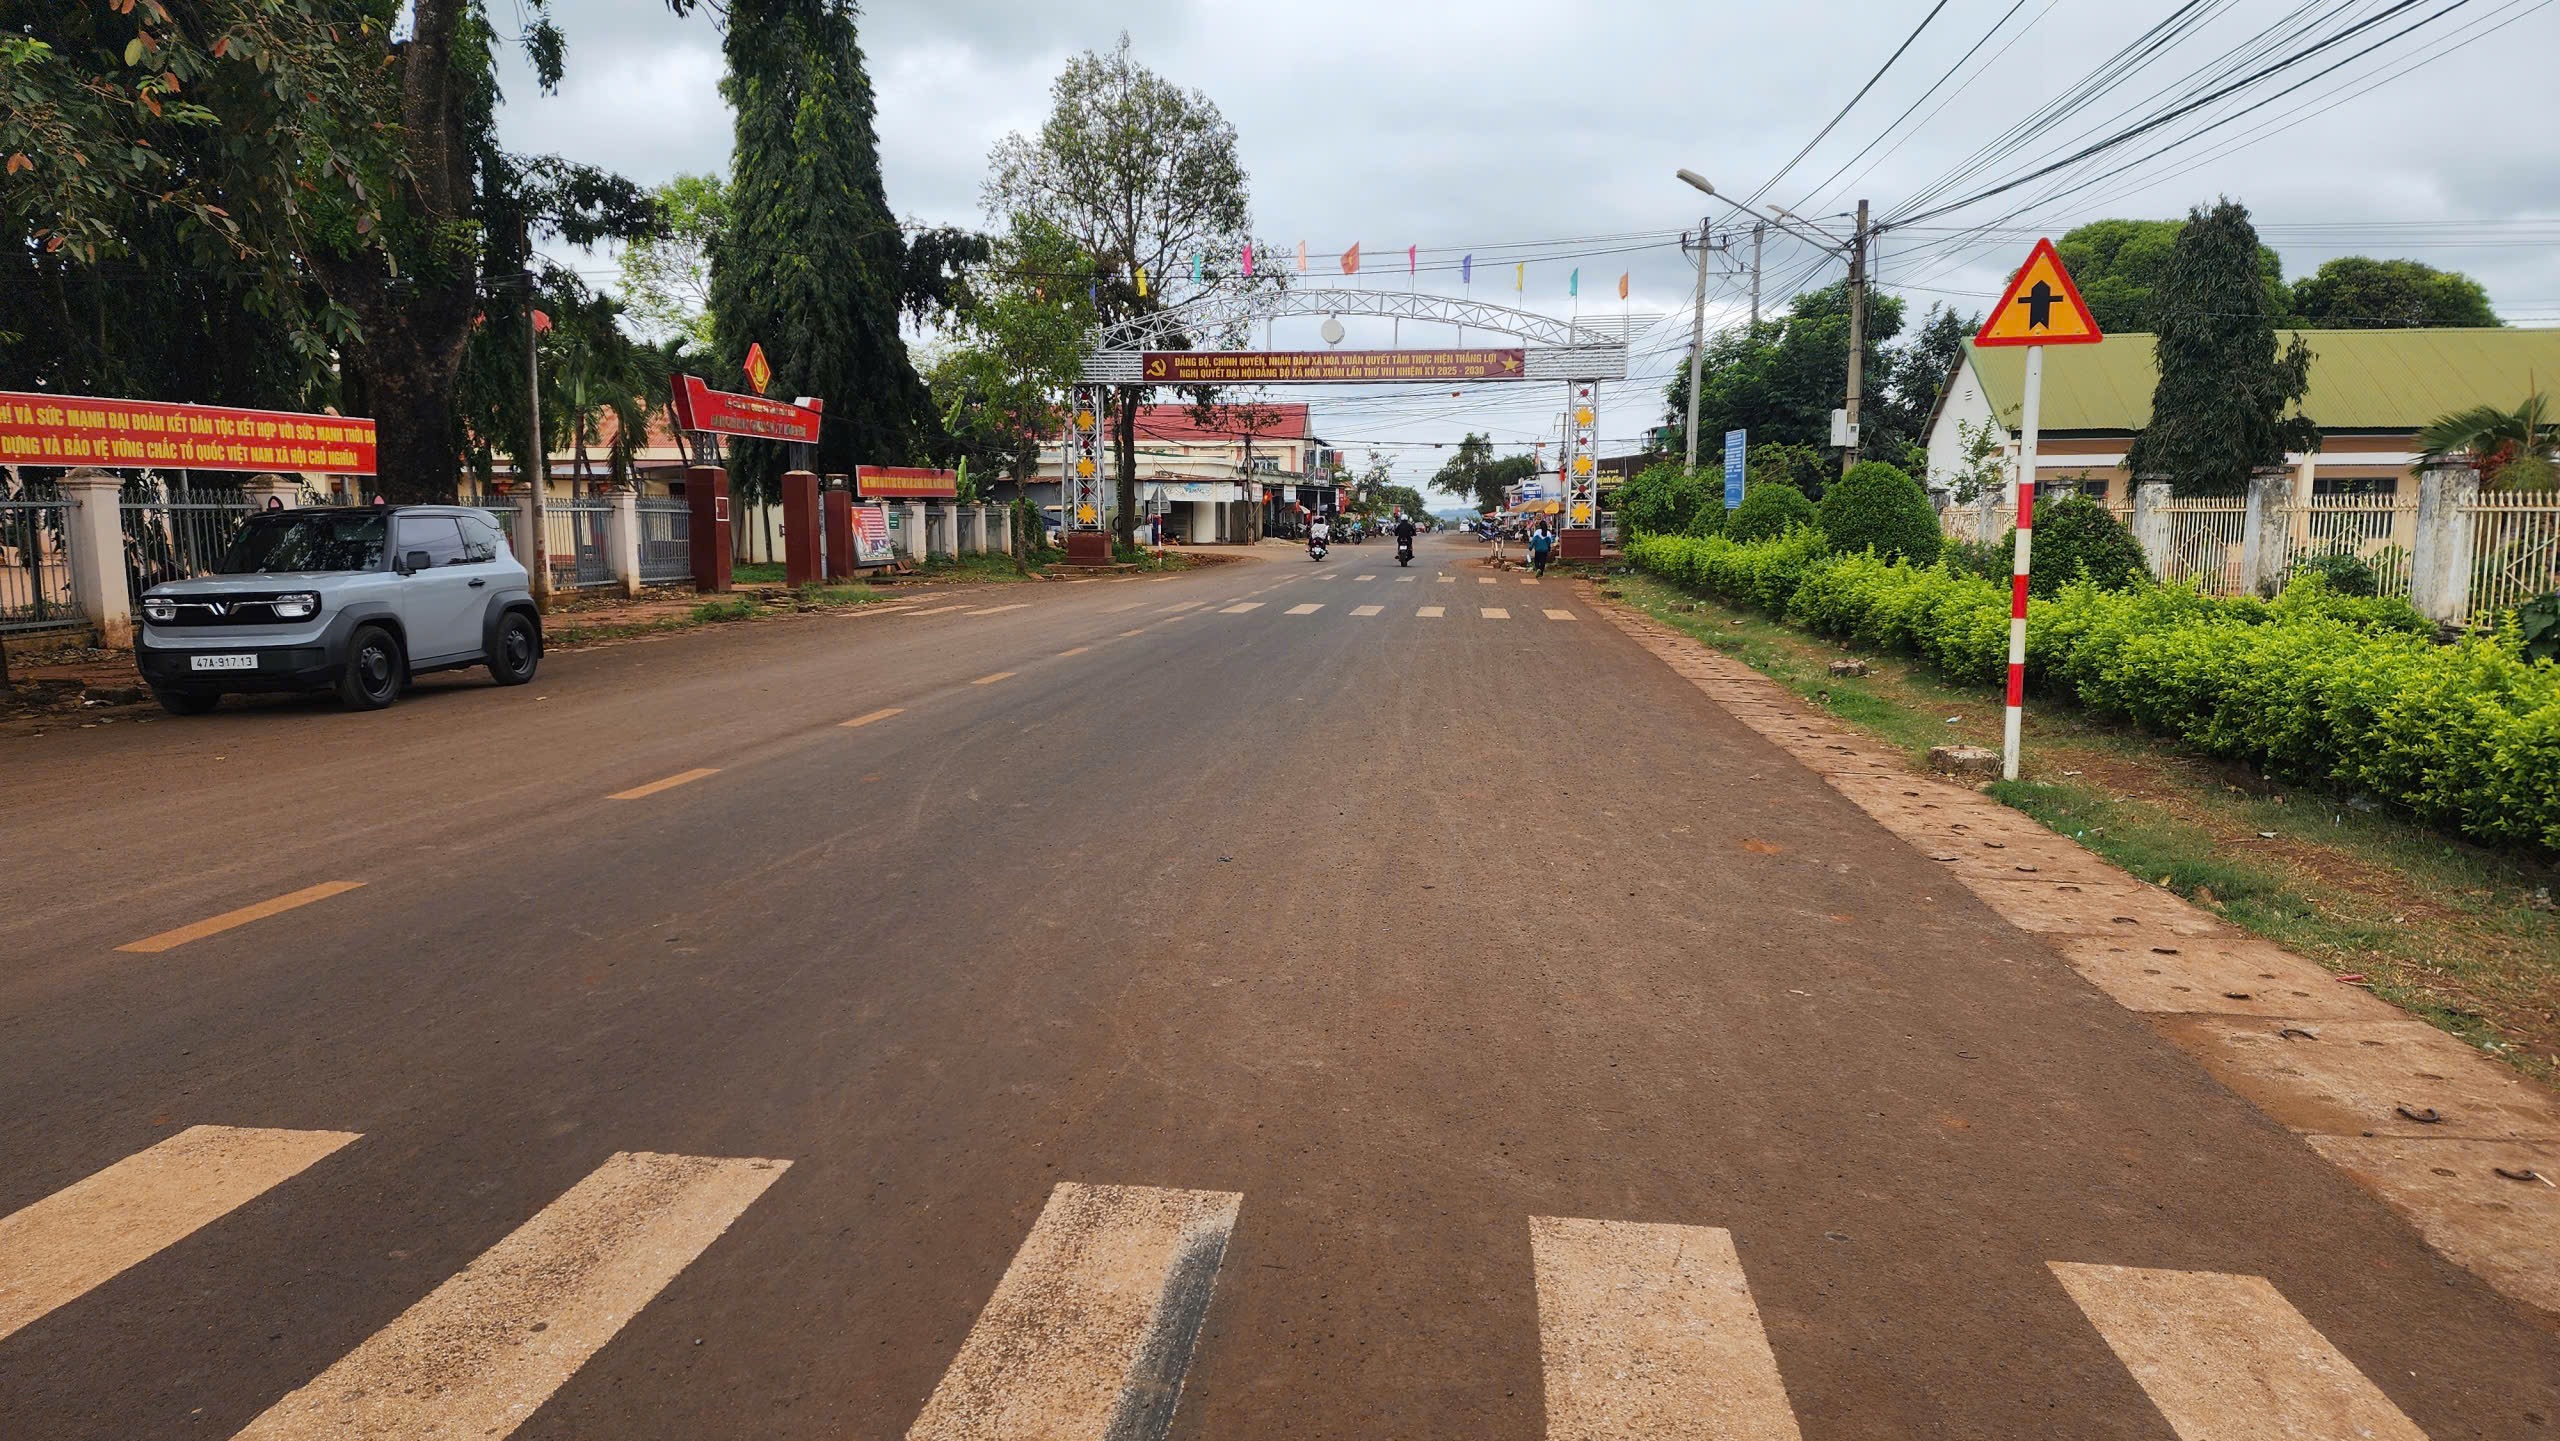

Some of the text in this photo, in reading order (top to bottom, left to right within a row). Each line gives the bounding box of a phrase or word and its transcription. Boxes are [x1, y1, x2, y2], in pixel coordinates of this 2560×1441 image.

[1174, 355, 1197, 367] ĐẢNG
[1213, 355, 1238, 366] CHÍNH
[1293, 354, 1310, 366] DÂN
[1311, 354, 1323, 366] XÃ
[1342, 354, 1364, 365] XUÂN
[1365, 353, 1391, 365] QUYẾT
[1392, 353, 1410, 364] TÂM
[1411, 353, 1432, 365] THỰC
[1434, 353, 1453, 365] HIỆN
[1455, 352, 1482, 364] THẮNG
[1483, 353, 1497, 365] LỢI
[1179, 368, 1199, 379] NGHỊ
[1200, 367, 1225, 379] QUYẾT
[1226, 368, 1240, 379] ĐẠI
[1241, 367, 1255, 379] HỘI
[1255, 366, 1278, 378] ĐẢNG
[1292, 366, 1303, 377] XÃ
[1322, 366, 1345, 377] XUÂN
[1381, 366, 1395, 376] VIII
[1396, 366, 1423, 377] NHIỆM
[1437, 366, 1457, 376] 2025
[1464, 366, 1485, 376] 2030
[13, 403, 34, 424] VÀ
[36, 405, 64, 426] SỨC
[66, 409, 106, 431] MẠNH
[108, 412, 130, 433] ĐẠI
[131, 411, 165, 432] ĐOÀN
[166, 411, 187, 433] KẾT
[189, 414, 213, 434] DÂN
[214, 416, 235, 439] TỘC
[236, 416, 255, 437] KẾT
[256, 421, 277, 440] HỢP
[295, 422, 315, 440] SỨC
[316, 426, 344, 444] MẠNH
[344, 425, 364, 443] THỜI
[364, 429, 377, 447] ĐẠ
[1, 433, 359, 467] DỰNG VÀ BẢO VỆ VỮNG CHẮC TỔ QUỐC VIỆT NAM XÃ HỘI CHỦ NGHĨA!
[196, 656, 253, 668] 47A-917.13
